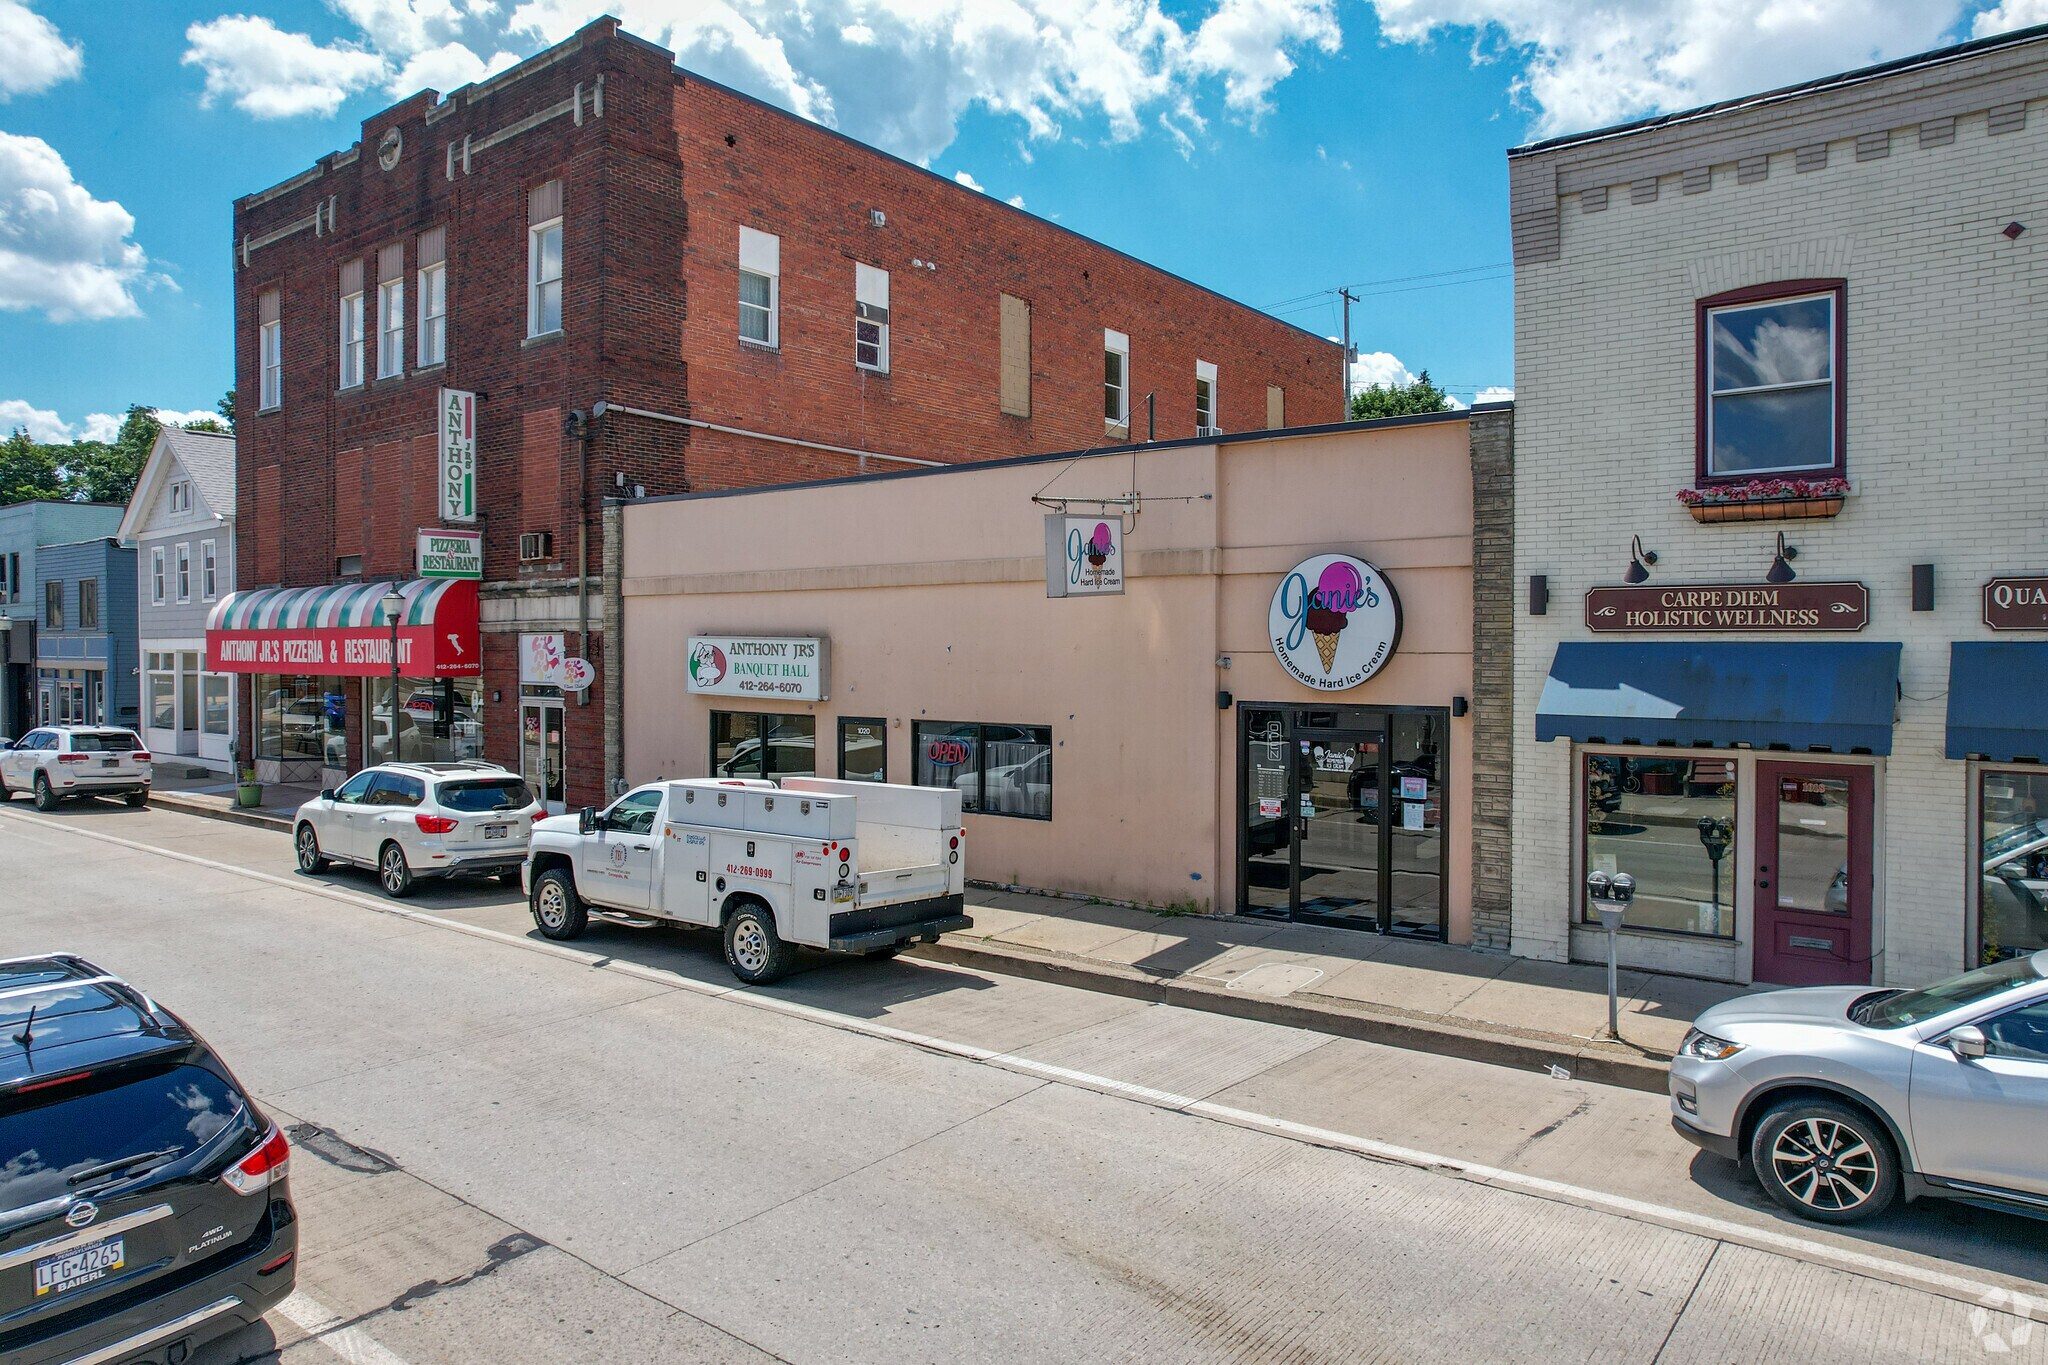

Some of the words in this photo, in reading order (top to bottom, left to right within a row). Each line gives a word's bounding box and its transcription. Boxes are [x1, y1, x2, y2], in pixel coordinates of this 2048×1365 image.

[447, 395, 462, 516] ANTHONY
[430, 538, 471, 554] PIZZERIA
[422, 554, 480, 571] RESTAURANT
[1085, 568, 1116, 576] Homemade
[1080, 578, 1094, 586] Hard
[1094, 578, 1102, 586] Ice
[1103, 577, 1120, 585] Cream
[1661, 591, 1723, 608] CARPE
[1725, 590, 1779, 607] DIEM
[1280, 572, 1380, 651] Janie's
[1626, 610, 1712, 627] HOLISTIC
[1715, 609, 1820, 626] WELLNESS
[220, 640, 258, 662] ANTHONY
[283, 639, 324, 663] PIZZERIA
[329, 639, 338, 663] &
[344, 638, 413, 664] RESTAURNT
[729, 642, 788, 657] ANTHONY
[734, 662, 779, 678] BANQUET
[782, 664, 810, 677] HALL
[1275, 637, 1316, 685] Homemade
[1319, 677, 1344, 689] Hard
[1346, 672, 1362, 685] Ice
[1361, 641, 1387, 674] Cream
[739, 680, 802, 693] 412-264-6070
[857, 727, 871, 735] 1020
[1269, 723, 1279, 759] OPEN
[928, 741, 966, 764] OPEN
[726, 863, 773, 879] 412-269-0999
[201, 1225, 224, 1238] 4WD
[188, 1230, 233, 1254] PLATINUM
[57, 1270, 106, 1293] BAIERL
